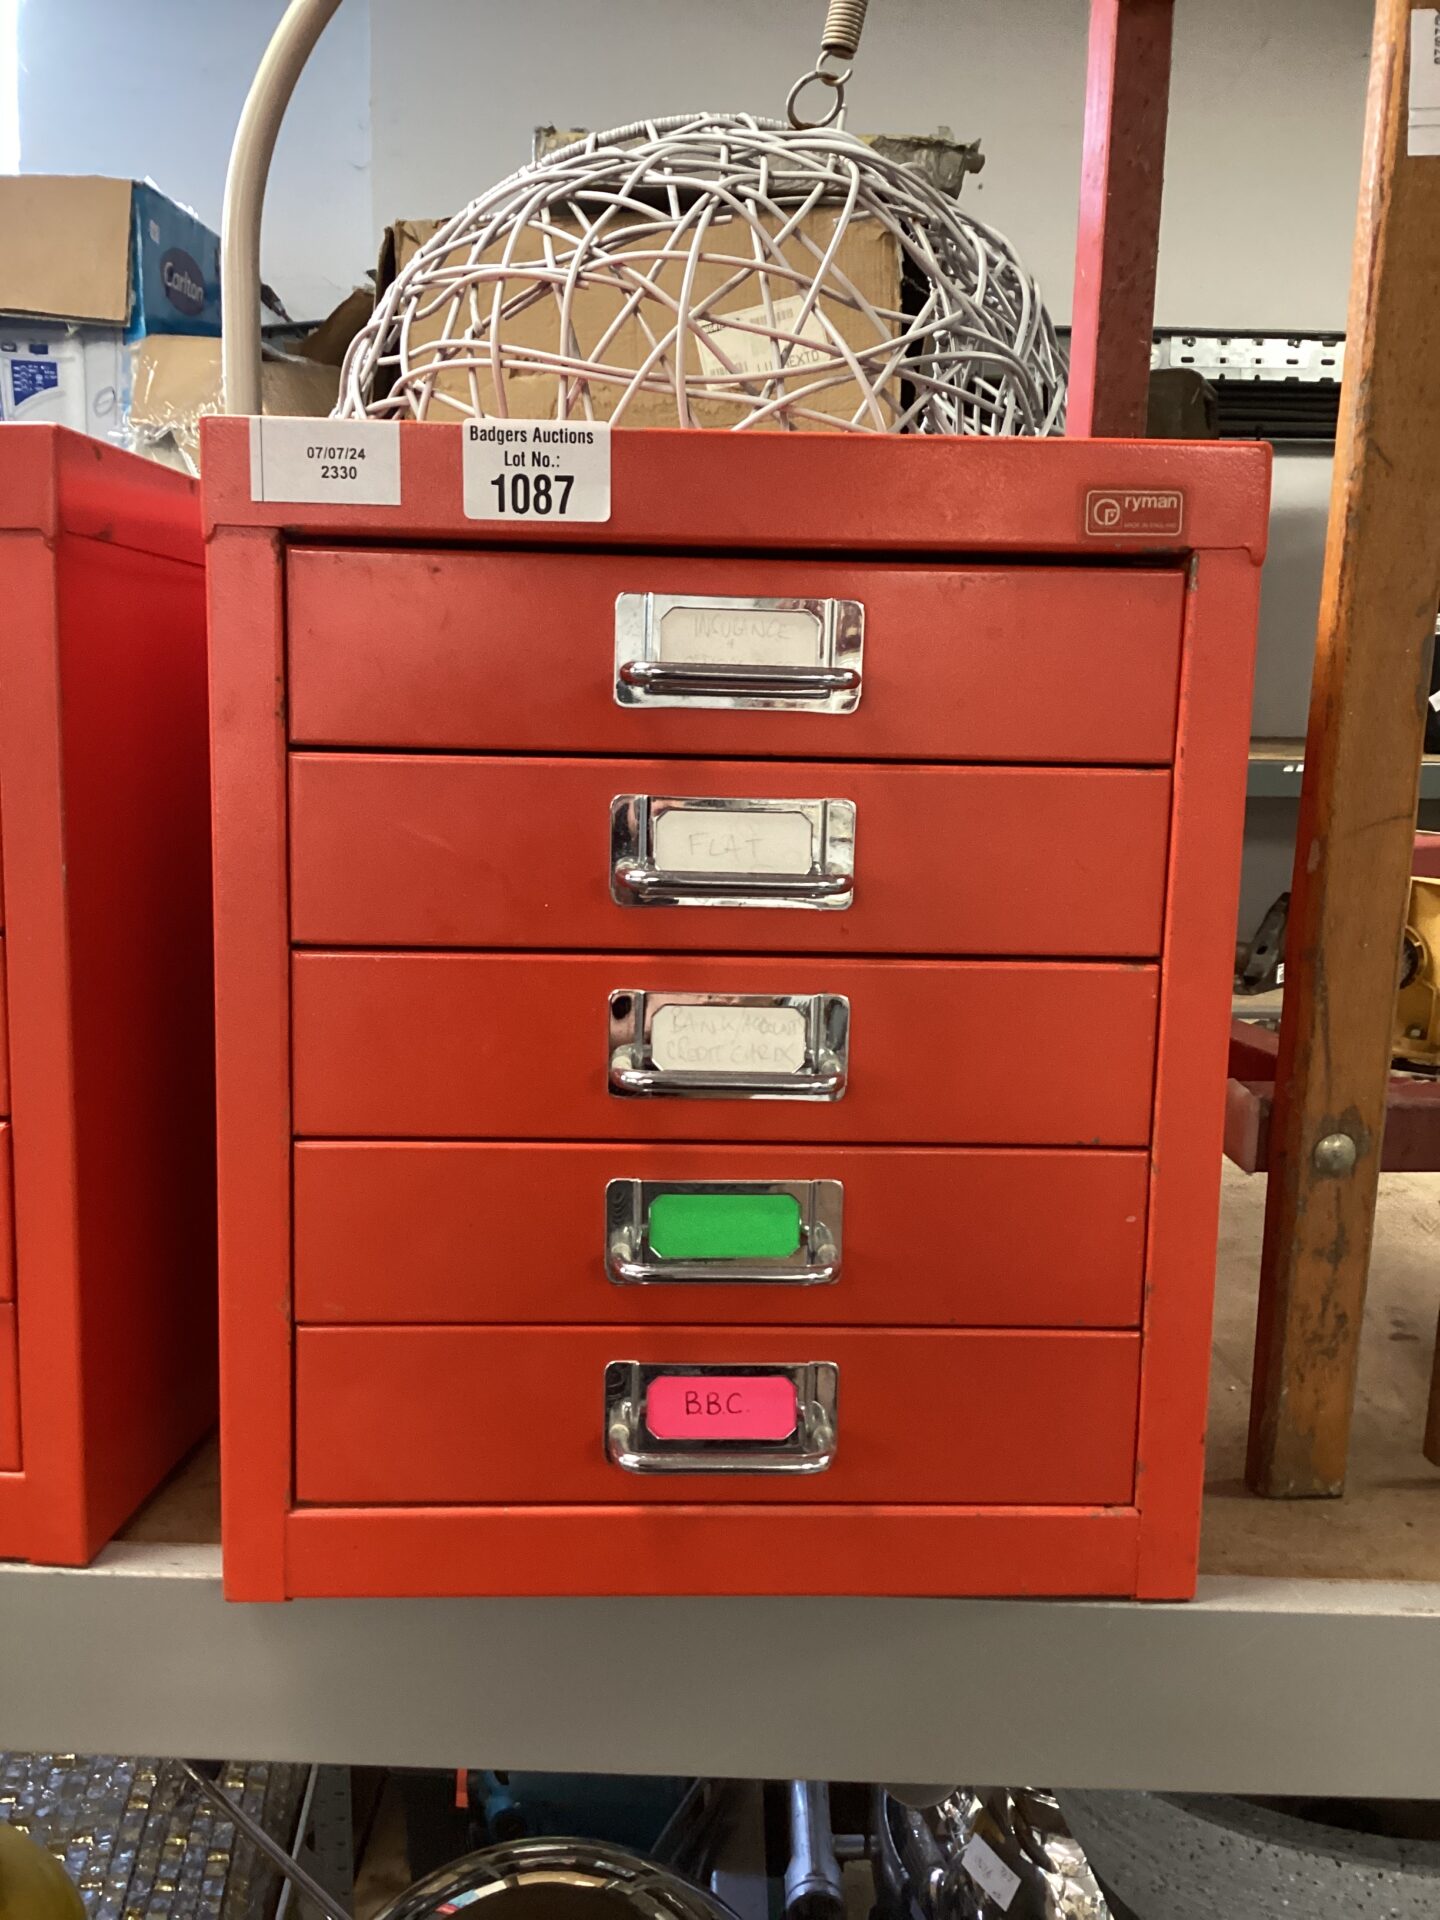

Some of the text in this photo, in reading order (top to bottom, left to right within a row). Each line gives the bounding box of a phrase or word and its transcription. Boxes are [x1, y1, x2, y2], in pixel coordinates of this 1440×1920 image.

[163, 261, 204, 304] Carlton
[786, 350, 820, 368] EXTD
[470, 425, 594, 446] Badgers Auctions
[306, 446, 366, 460] 07/07/24
[504, 450, 560, 468] Lot No.:
[321, 465, 358, 480] 2330
[490, 473, 575, 515] 1087
[1124, 496, 1178, 512] ryman
[688, 830, 764, 862] FLAT
